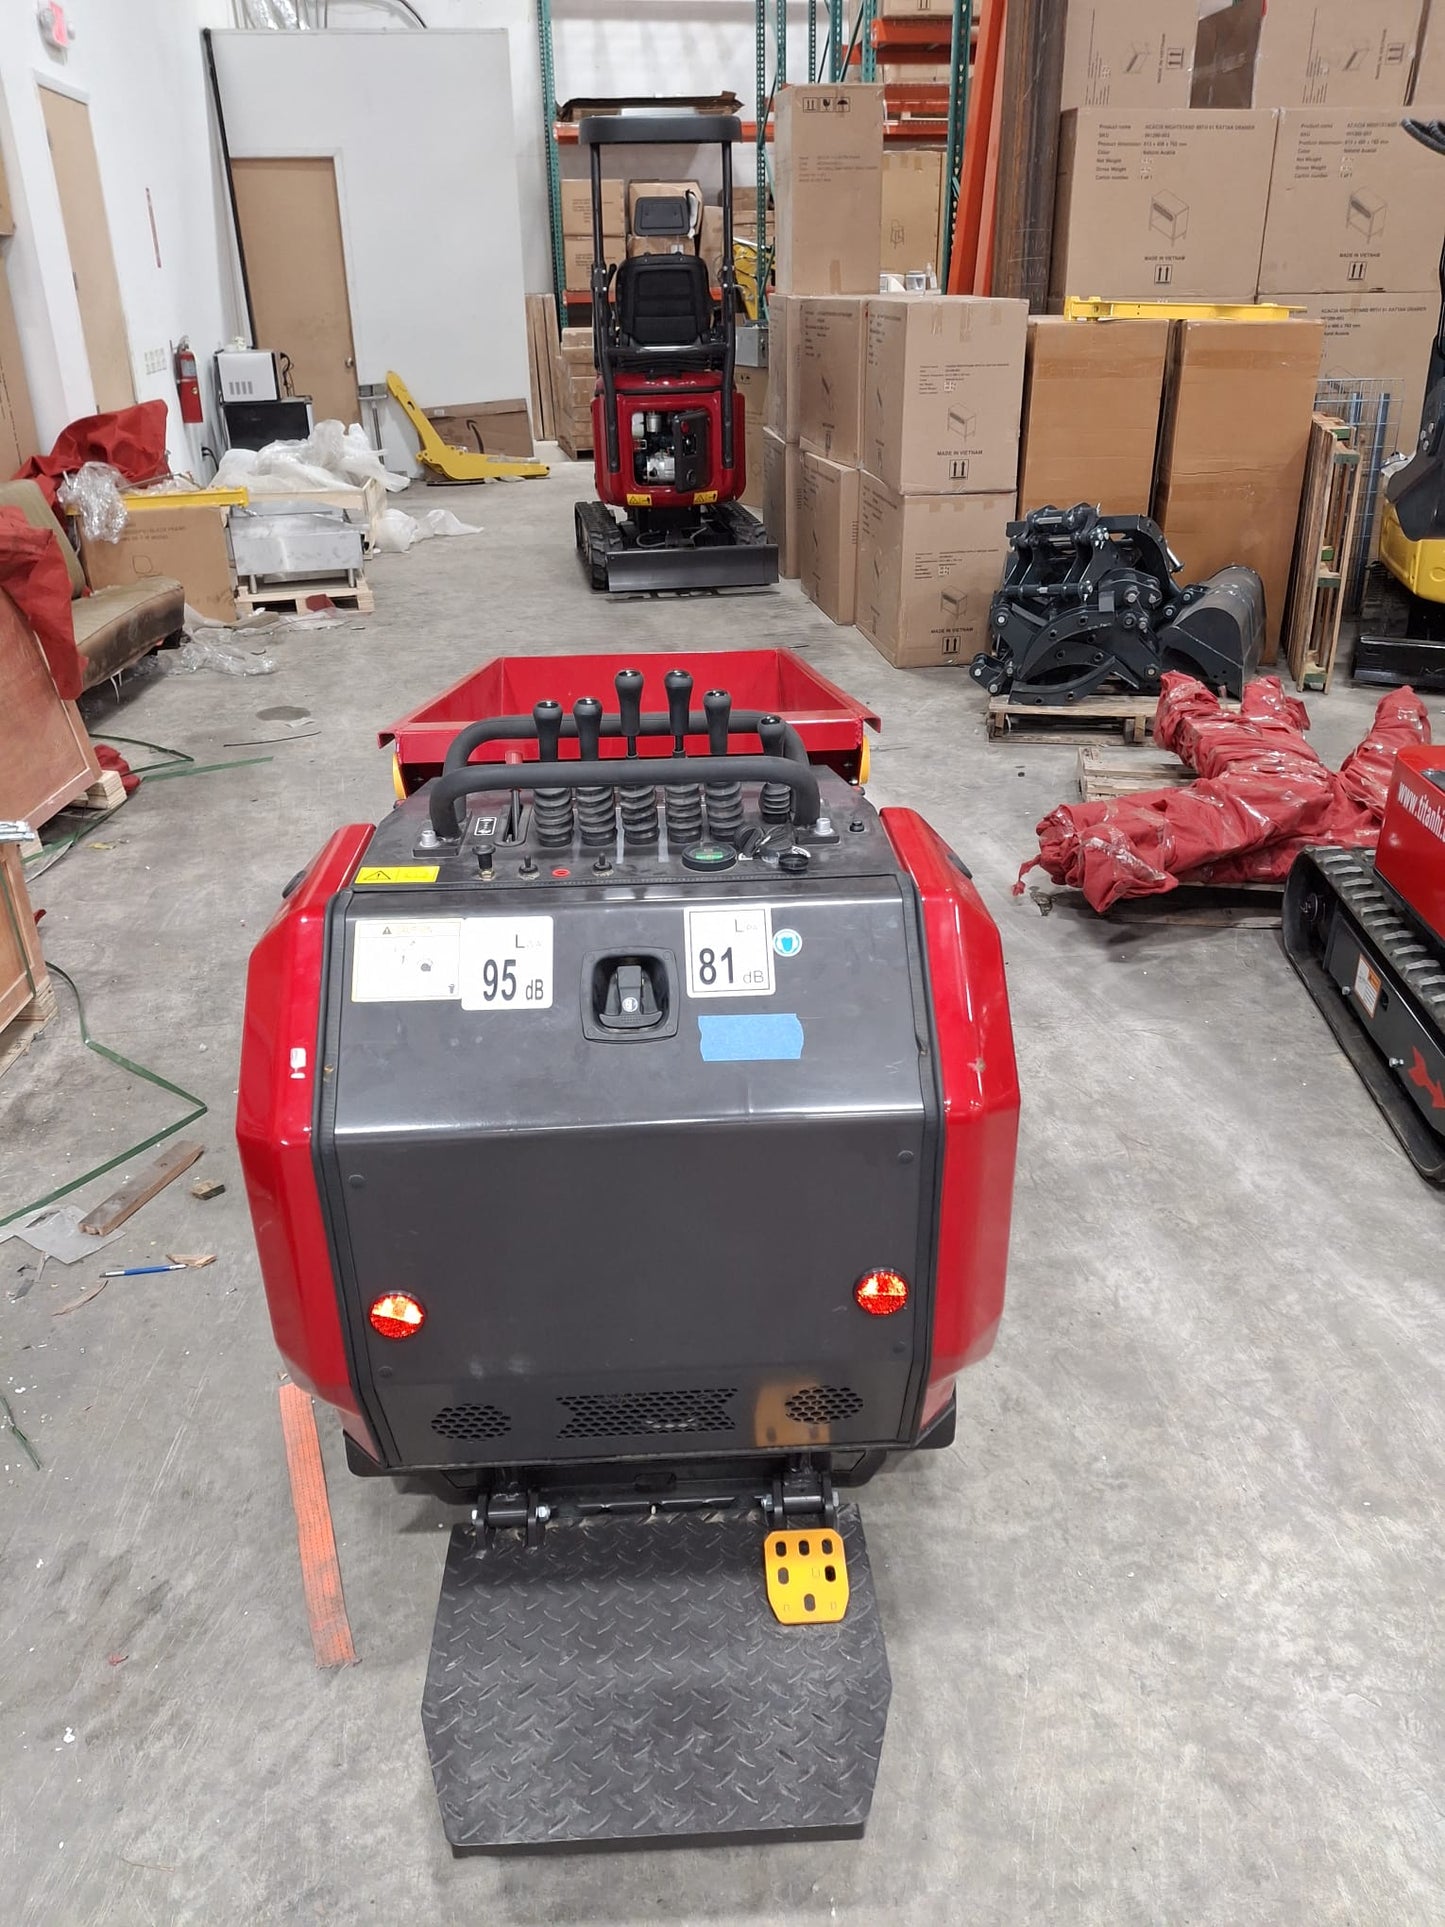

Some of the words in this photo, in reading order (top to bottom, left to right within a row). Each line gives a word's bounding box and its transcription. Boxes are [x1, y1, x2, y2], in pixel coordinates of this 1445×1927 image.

[483, 959, 517, 1002] 95
[525, 979, 545, 1000] dB
[699, 947, 734, 985] 81
[743, 970, 765, 984] dB
